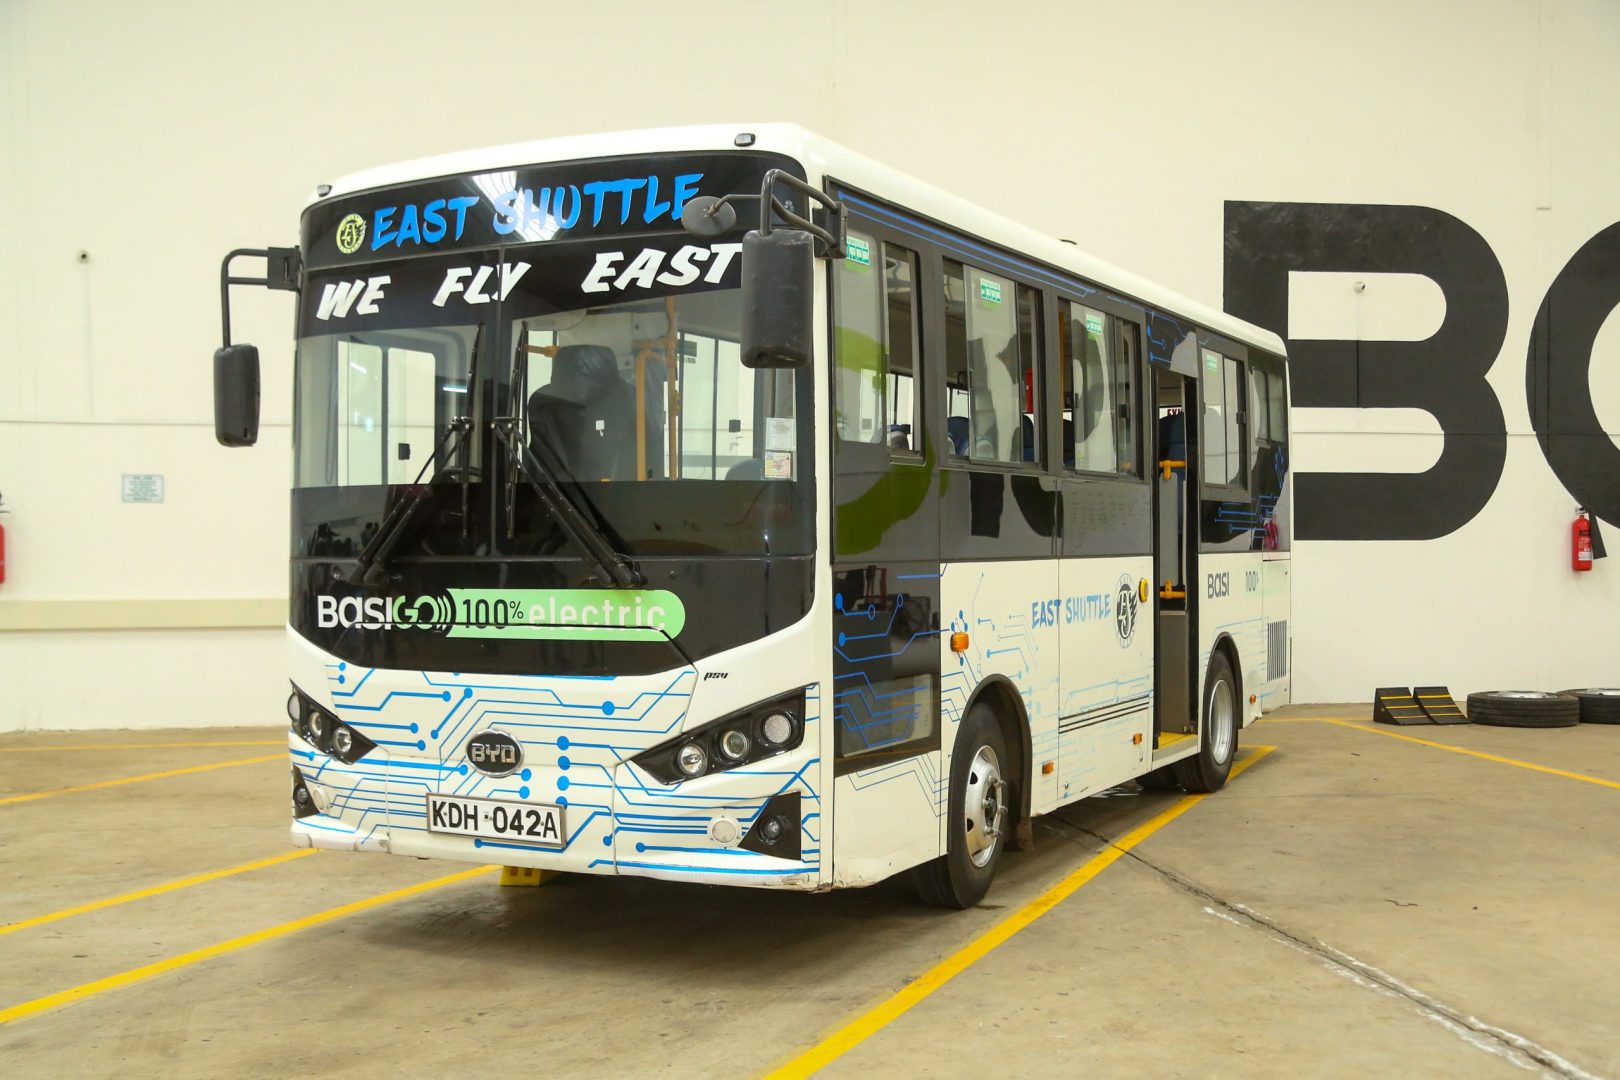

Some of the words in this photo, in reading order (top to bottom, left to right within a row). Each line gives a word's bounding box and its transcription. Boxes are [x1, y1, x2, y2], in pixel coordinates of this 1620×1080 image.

[371, 196, 480, 251] EAST
[493, 173, 704, 235] SHUTTLE
[316, 275, 392, 321] WE
[432, 261, 532, 307] FLY
[581, 242, 743, 294] EAST
[463, 599, 524, 630] 100%
[528, 596, 667, 632] electric
[1031, 599, 1062, 630] EAST
[1065, 593, 1111, 624] SHUTTLE
[471, 742, 516, 764] BYD
[432, 800, 479, 832] KDH
[492, 806, 559, 840] 042A
